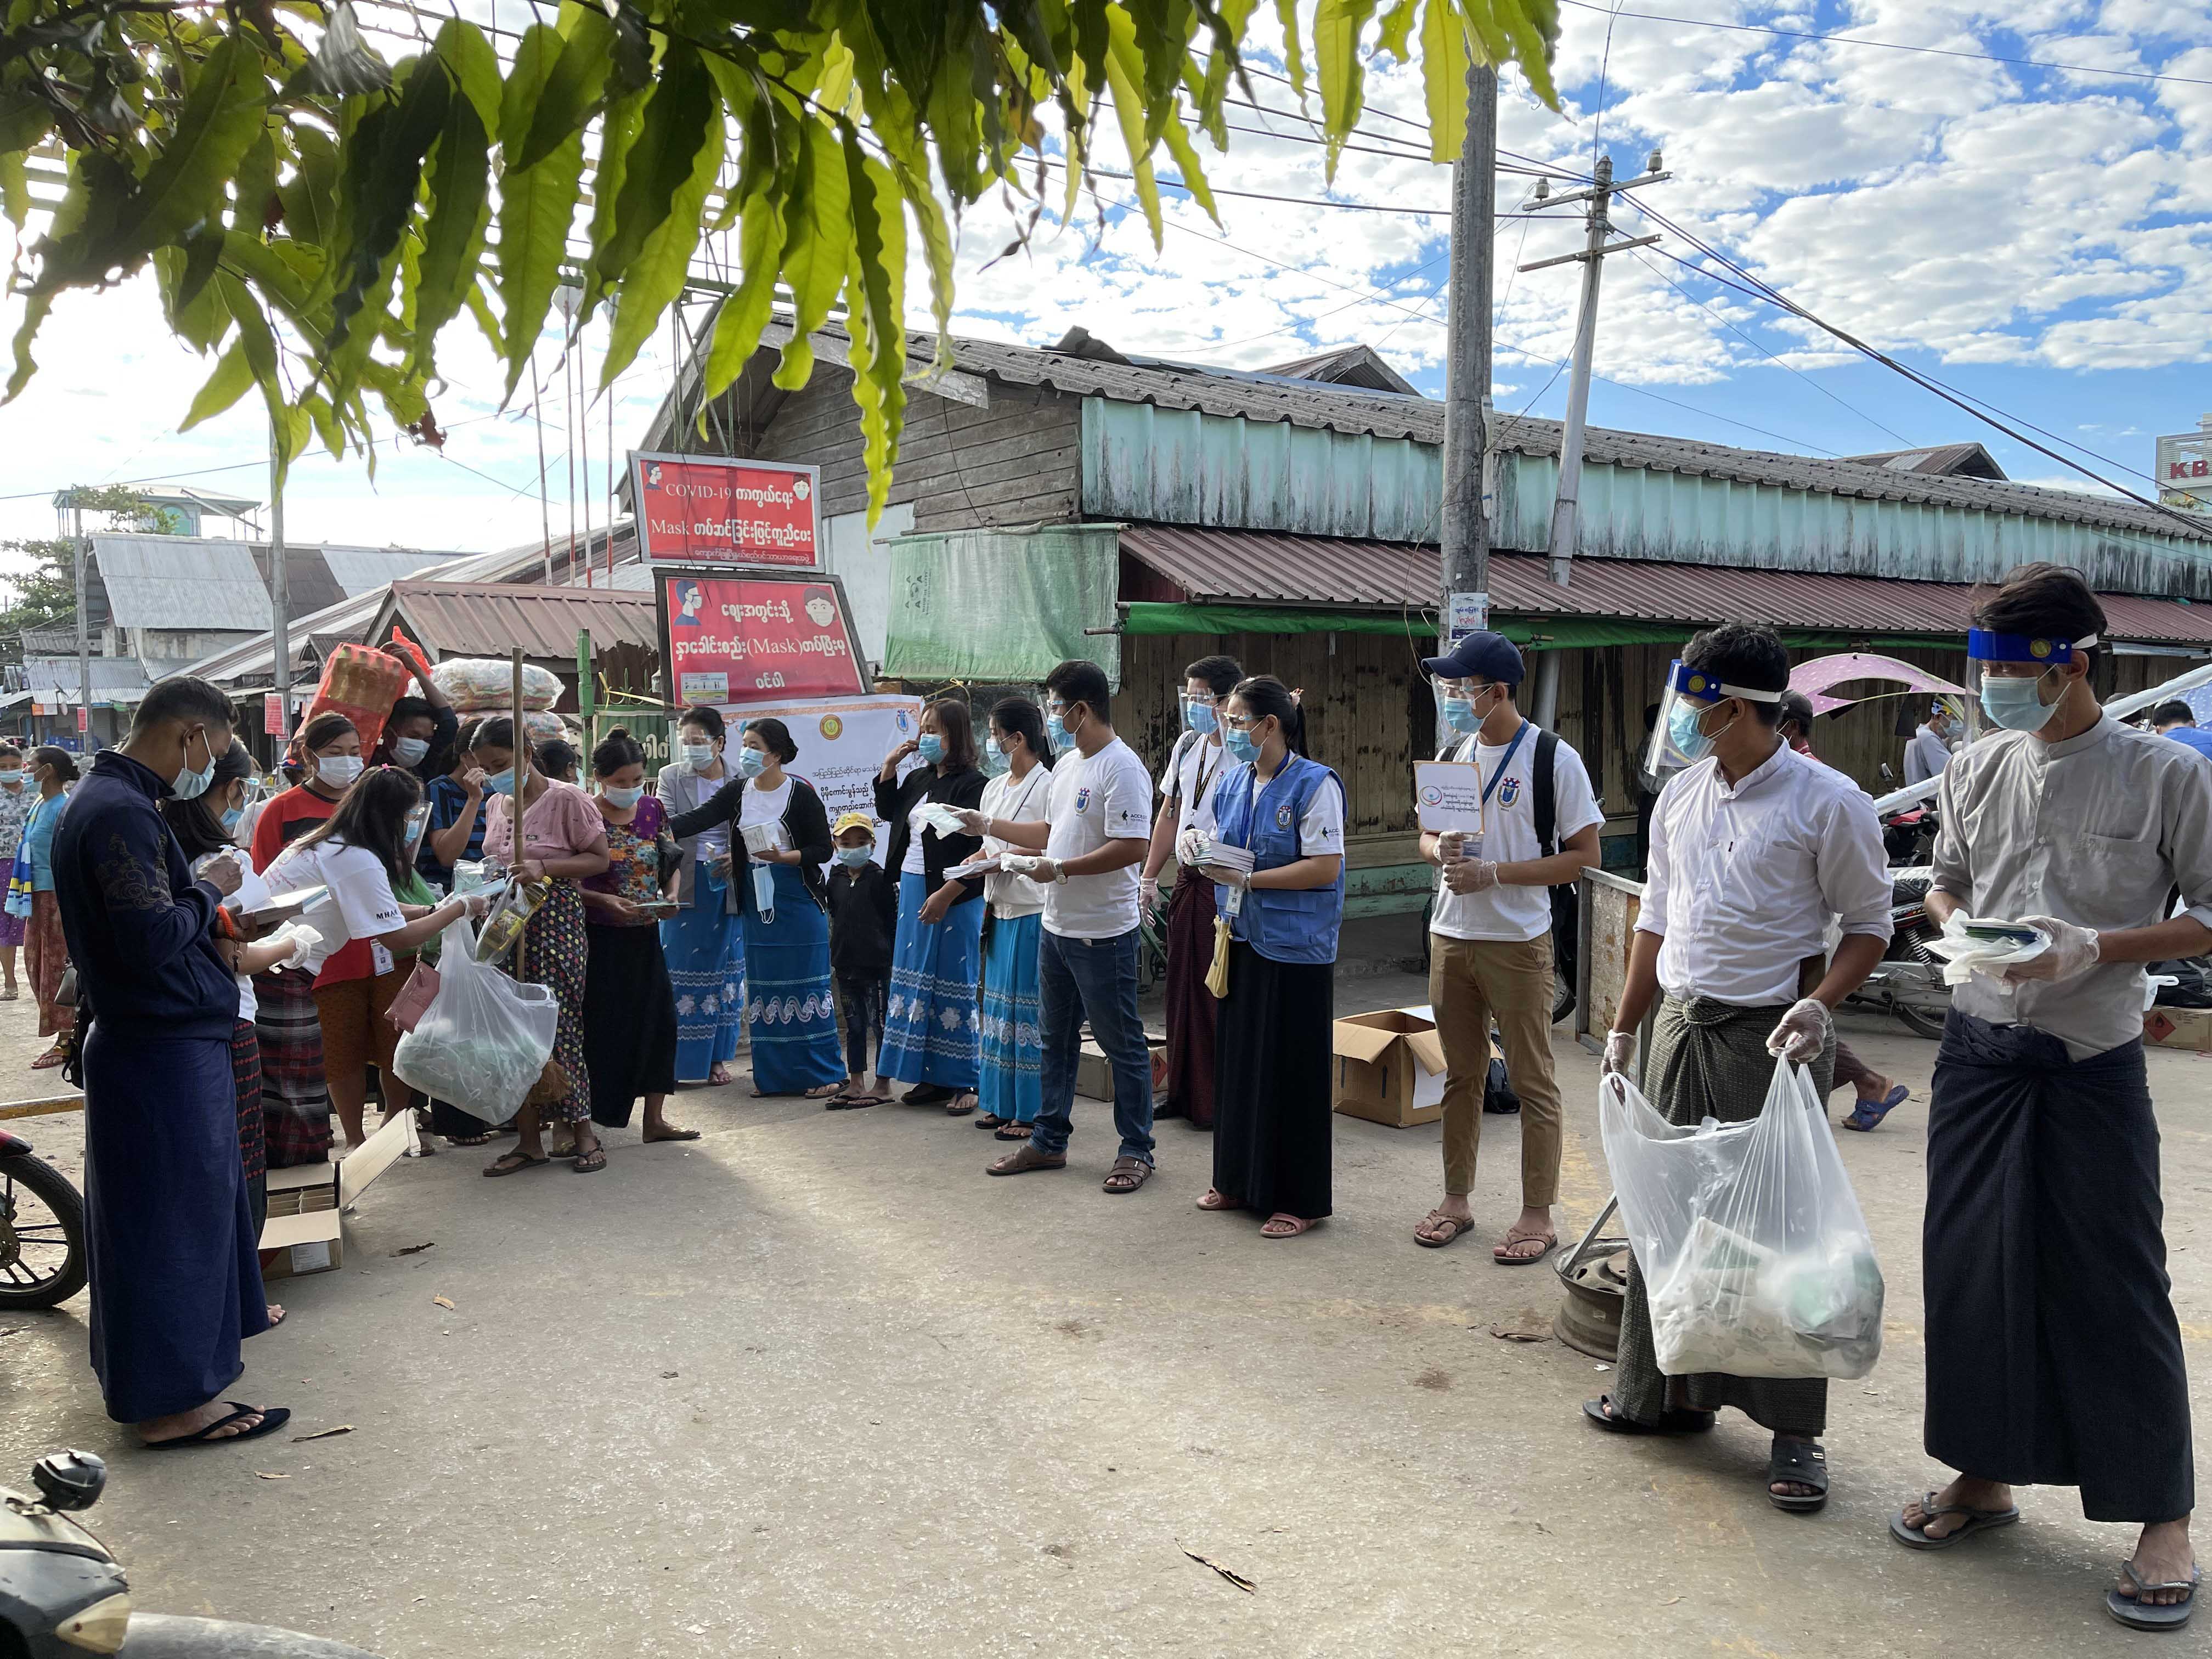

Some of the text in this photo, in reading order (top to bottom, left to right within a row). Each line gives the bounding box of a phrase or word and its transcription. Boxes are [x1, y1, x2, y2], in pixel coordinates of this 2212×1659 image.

[666, 483, 793, 510] COVID-19 ကာကွယ်ရေး
[651, 519, 690, 535] Mask
[755, 672, 785, 689] ဝင်ပါ
